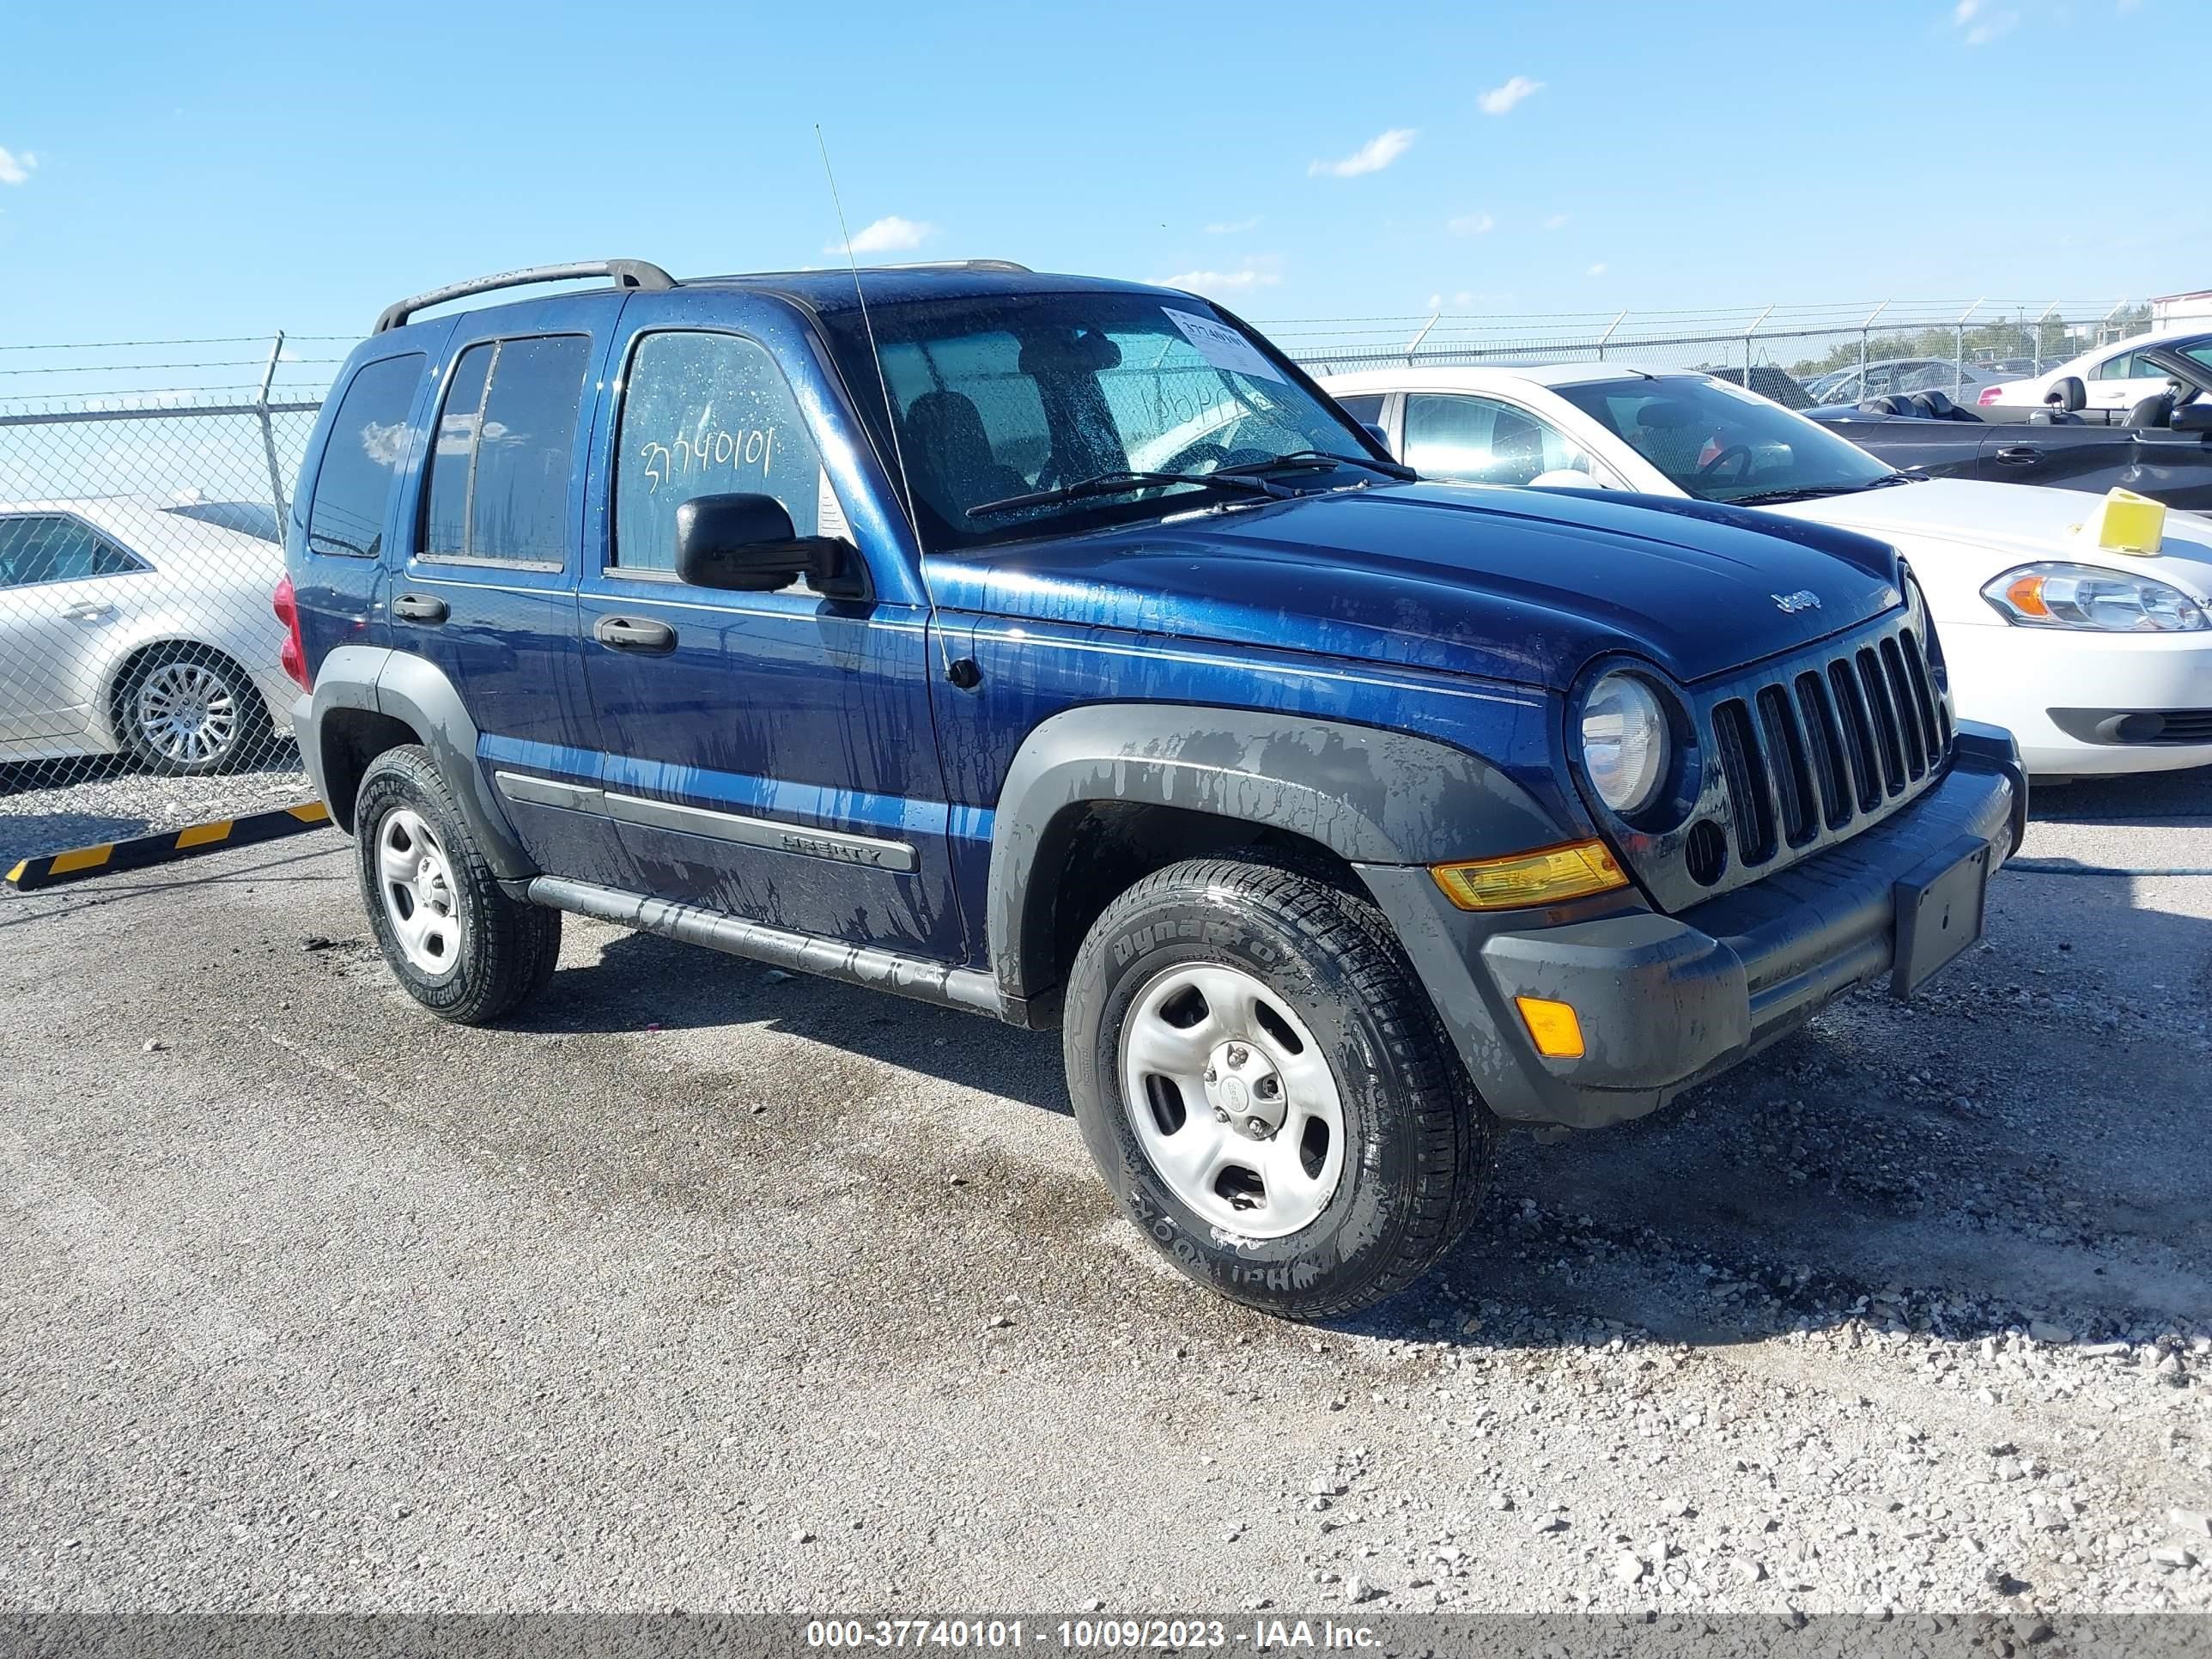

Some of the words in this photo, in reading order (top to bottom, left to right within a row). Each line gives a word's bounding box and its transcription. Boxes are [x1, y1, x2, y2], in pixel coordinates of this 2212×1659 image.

[1182, 321, 1248, 349] 37740101
[641, 428, 773, 494] 37740101
[1770, 590, 1821, 613] Jeep
